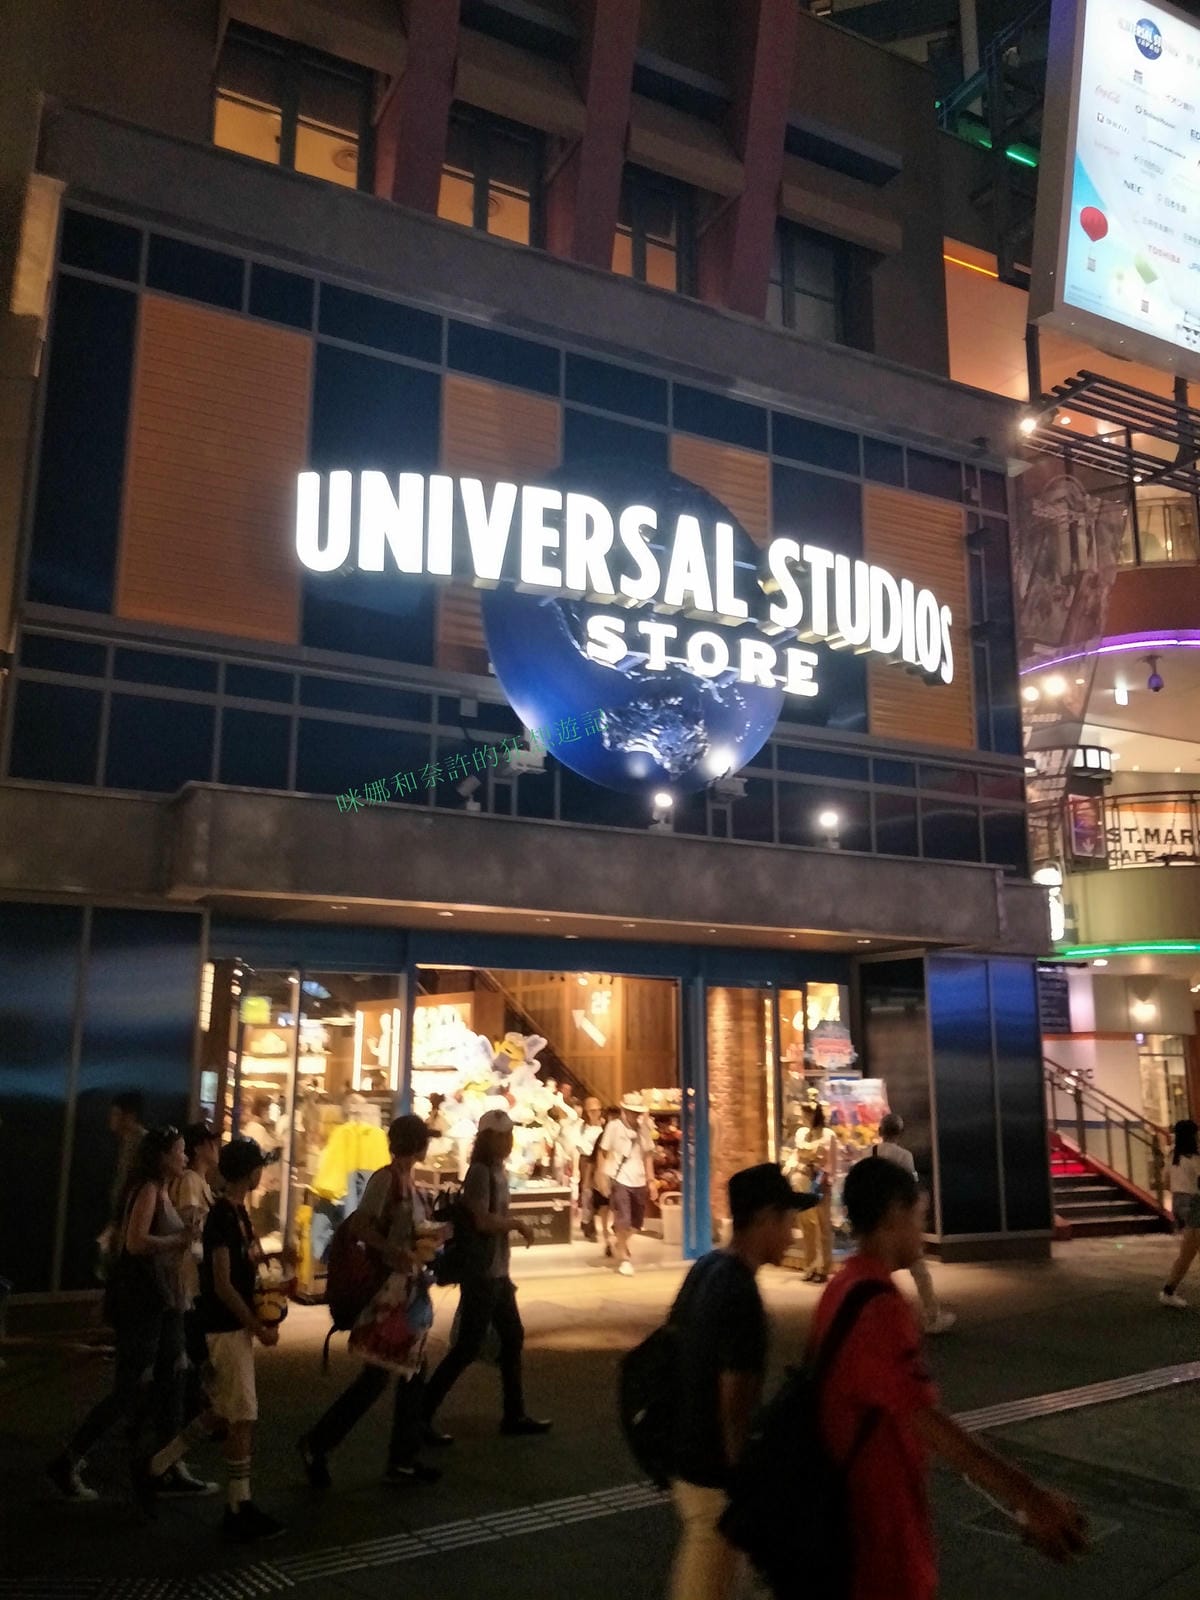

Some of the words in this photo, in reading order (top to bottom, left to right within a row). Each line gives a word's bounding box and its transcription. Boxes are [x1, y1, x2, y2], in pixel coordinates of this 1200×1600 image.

[1123, 180, 1144, 195] NEC
[294, 470, 750, 622] UNIVERSAL
[767, 537, 954, 686] STUDIOS
[585, 613, 820, 698] STORE
[1106, 828, 1200, 845] ST.MAR
